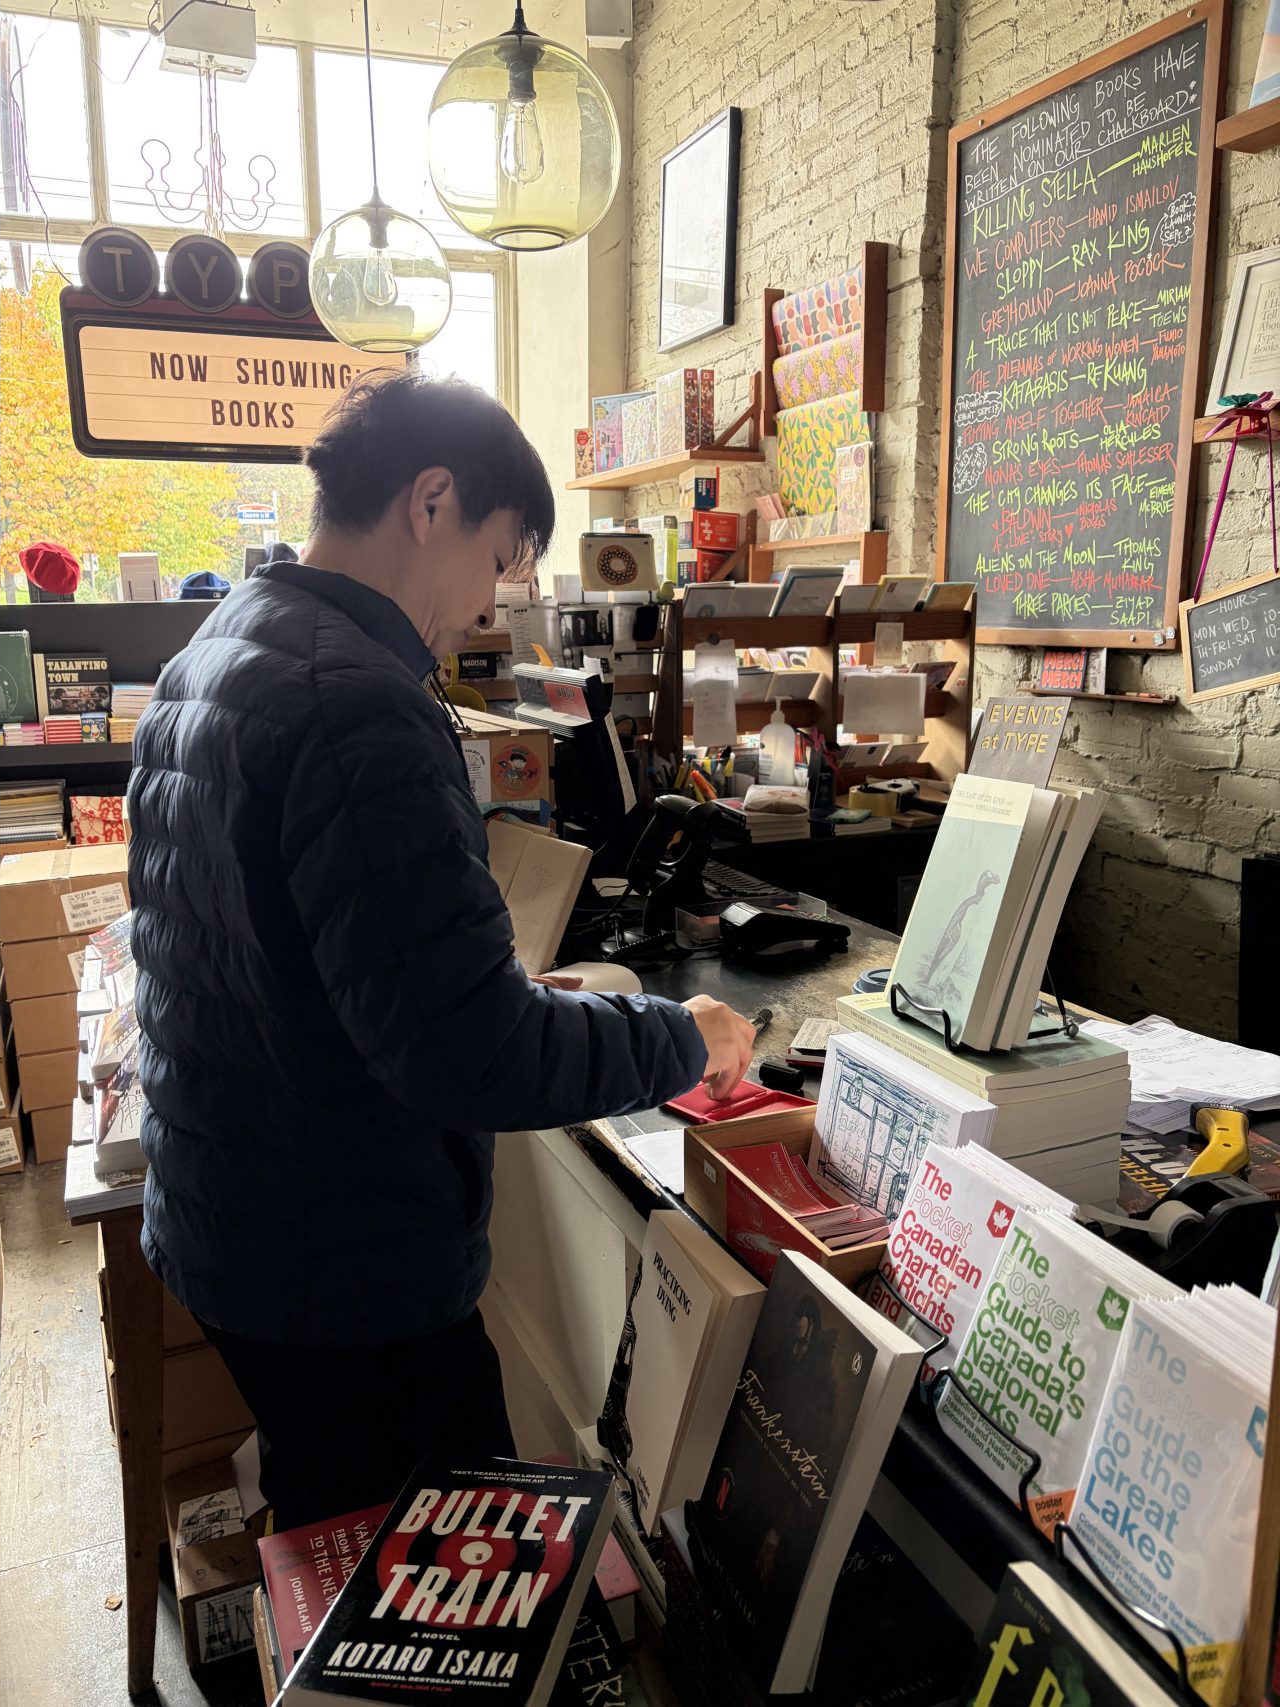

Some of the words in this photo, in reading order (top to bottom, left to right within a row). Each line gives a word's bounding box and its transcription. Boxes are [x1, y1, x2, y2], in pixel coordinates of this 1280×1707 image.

[972, 136, 1000, 164] THE
[1011, 94, 1079, 146] FOLLOWING
[1095, 67, 1141, 108] BOOKS
[1153, 42, 1199, 81] HAVE
[965, 165, 999, 194] BEEN
[1013, 121, 1090, 172] NOMINATED
[1097, 109, 1116, 129] TO
[1127, 91, 1146, 117] BE
[1132, 143, 1198, 178] HAUSHOFER
[965, 174, 1017, 211] WRITTEN
[1028, 158, 1045, 177] ON
[1055, 142, 1090, 165] OUR
[973, 186, 1035, 244] KILLING
[1041, 157, 1098, 207] STELLA
[1139, 119, 1191, 158] MARLEN
[964, 246, 988, 280] WE
[995, 215, 1066, 269] COMPUTERS
[1087, 200, 1118, 230] HAMID
[1125, 175, 1179, 214] ISMAILOV
[996, 250, 1045, 300] SLOPPY
[1072, 237, 1101, 273] RAX
[1107, 218, 1150, 260] KING
[981, 287, 1054, 335] GREYHOUND
[1070, 274, 1119, 302] JOANNA
[1124, 246, 1185, 284] POCOCK
[984, 328, 1028, 361] TRUCE
[1031, 312, 1062, 348] THAT
[1106, 298, 1147, 331] PEACE
[1157, 283, 1192, 308] MIRIAM
[1149, 305, 1188, 328] TOEWS
[150, 352, 208, 382] NOW
[967, 368, 991, 395] THE
[1062, 340, 1103, 367] WORKING
[1105, 332, 1139, 359] WOMEN
[1002, 371, 1068, 412] KATABASIS
[1005, 408, 1046, 437] MYSELF
[1051, 394, 1107, 428] TOGETHER
[1122, 385, 1178, 409] JAMAICA
[211, 399, 295, 429] BOOKS
[1125, 405, 1170, 429] KINCAID
[992, 438, 1039, 465] STRONG
[1042, 429, 1078, 459] ROOTS
[1099, 423, 1161, 452] HERCULES
[1028, 458, 1060, 480] EYES
[964, 492, 990, 516] THE
[1025, 479, 1078, 506] CHANGES
[1001, 508, 1051, 536] BALDWIN
[974, 549, 1016, 575] ALIENS
[1063, 540, 1096, 565] MOON
[1114, 537, 1161, 556] THOMAS
[1122, 556, 1154, 579] KING
[985, 574, 1023, 593] LOVED
[1012, 591, 1048, 620] THREE
[1051, 592, 1092, 617] PARTIES
[1115, 596, 1154, 609] ZIYAD
[1110, 610, 1150, 626] SAADI
[47, 660, 108, 671] TARANTINO
[48, 673, 79, 683] TOWN
[462, 659, 488, 668] MADISON
[1042, 670, 1083, 690] MERCI
[1199, 654, 1242, 677] SUNDAY
[989, 704, 1064, 726] EVENTS
[981, 733, 999, 749] at
[1004, 733, 1049, 753] TYPE
[921, 1160, 952, 1201] The
[908, 1184, 973, 1248] Pocket
[891, 1233, 957, 1300] Charter
[901, 1210, 982, 1290] Canadian
[1010, 1225, 1050, 1279] The
[653, 1251, 693, 1317] PRACTICING
[897, 1270, 955, 1335] Rights
[995, 1251, 1080, 1341] Pocket
[656, 1286, 677, 1323] DYING
[872, 1286, 901, 1323] and
[986, 1282, 1053, 1354] Guide
[1059, 1341, 1086, 1383] to
[1130, 1316, 1187, 1385] The
[955, 1356, 1020, 1438] Parks
[965, 1330, 1064, 1438] National
[737, 1369, 830, 1502] Frankenstein
[942, 1404, 984, 1450] Conservation
[1112, 1386, 1202, 1480] Guide
[1103, 1414, 1131, 1458] to
[1140, 1446, 1191, 1511] the
[395, 1487, 590, 1542] BULLET
[1035, 1497, 1062, 1511] poster
[1094, 1447, 1179, 1544] Great
[1040, 1511, 1065, 1524] inside
[1084, 1473, 1176, 1581] Lakes
[314, 1536, 324, 1550] TO
[337, 1529, 350, 1552] FROM
[317, 1550, 330, 1574] THE
[289, 1577, 303, 1602] JOHN
[297, 1602, 313, 1633] BLAIR
[370, 1563, 550, 1628] TRAIN
[422, 1633, 461, 1641] NOVEL
[327, 1641, 434, 1673] KOTARO
[437, 1649, 519, 1679] ISAKA
[340, 1671, 406, 1682] INTERNATIONAL
[408, 1676, 466, 1686] BESTSELLING
[468, 1680, 510, 1688] THRILLER
